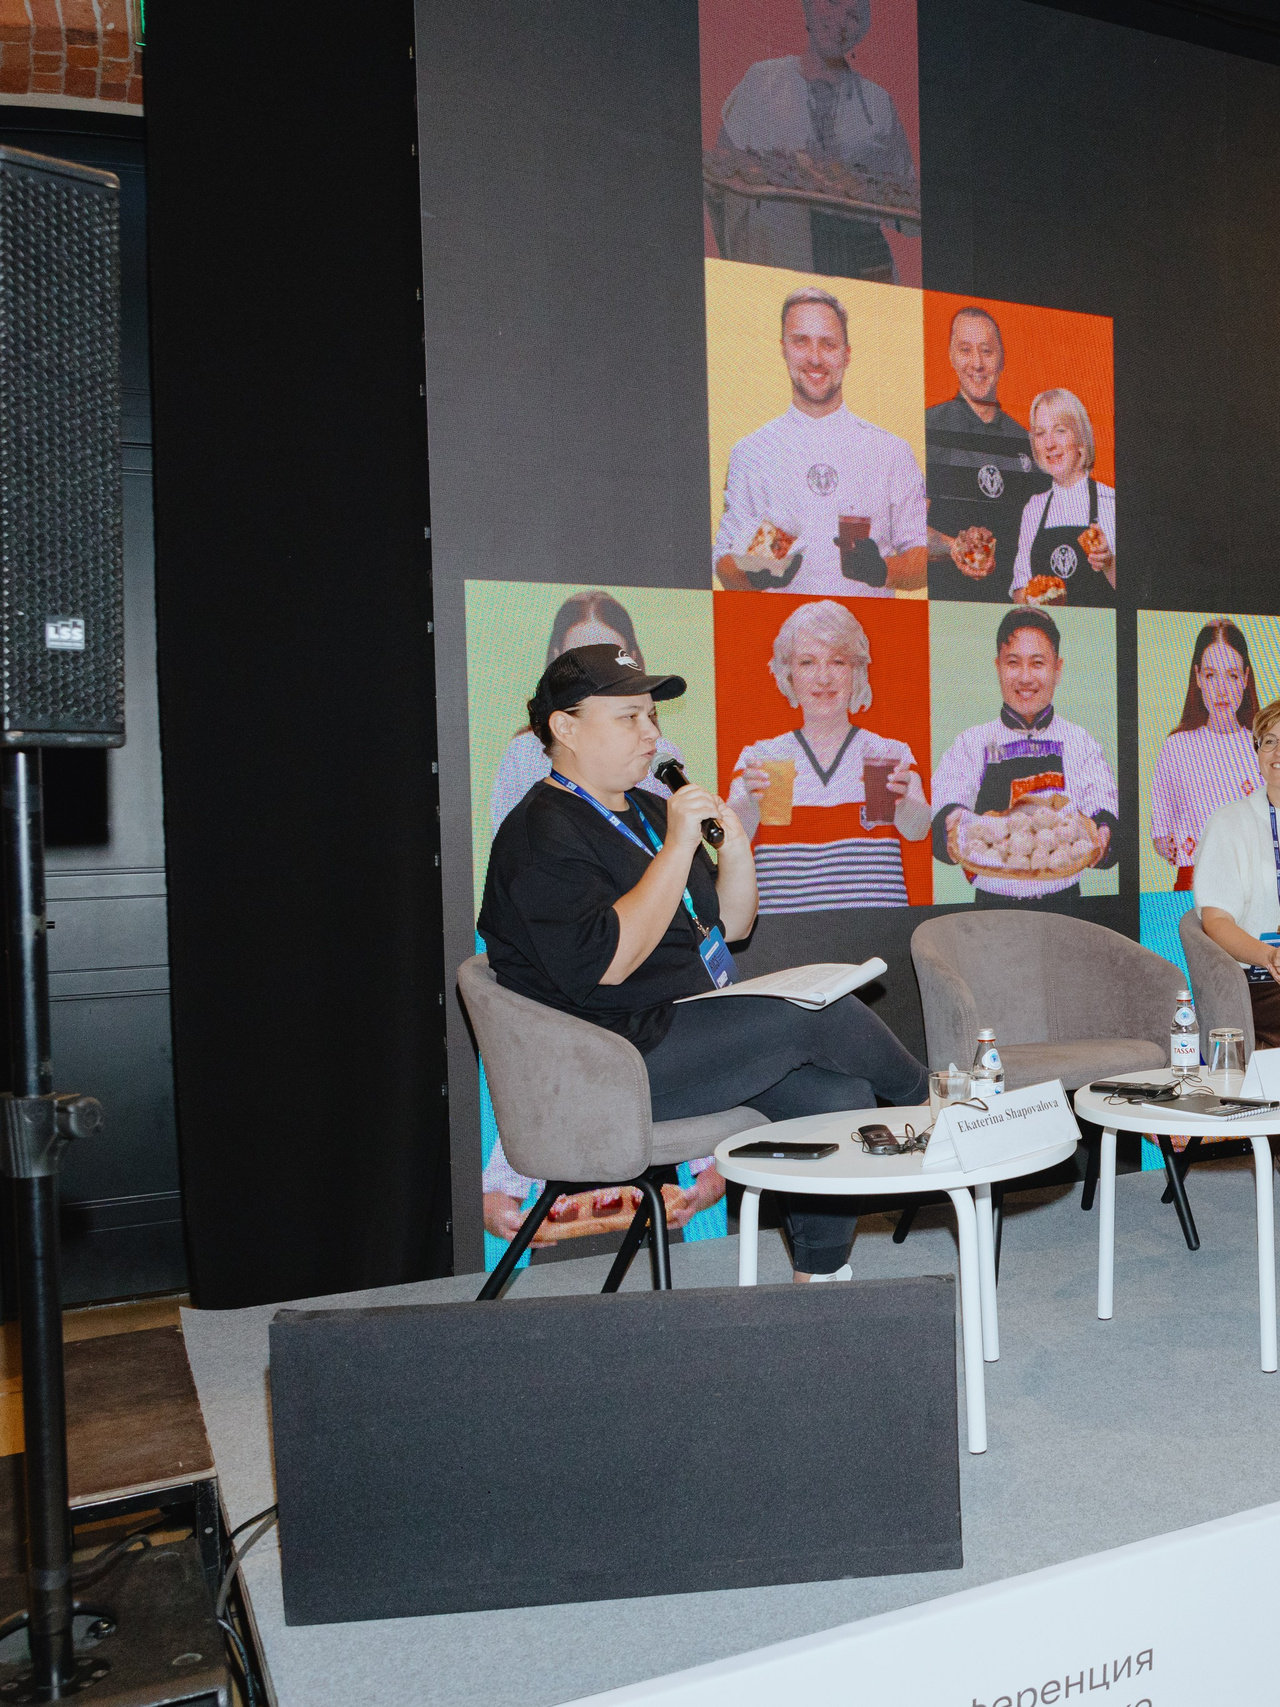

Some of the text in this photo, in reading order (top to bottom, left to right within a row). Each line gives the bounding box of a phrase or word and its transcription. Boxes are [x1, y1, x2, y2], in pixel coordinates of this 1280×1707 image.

[48, 626, 83, 641] LSS
[957, 1098, 1060, 1133] Ekaterina Shapovalova
